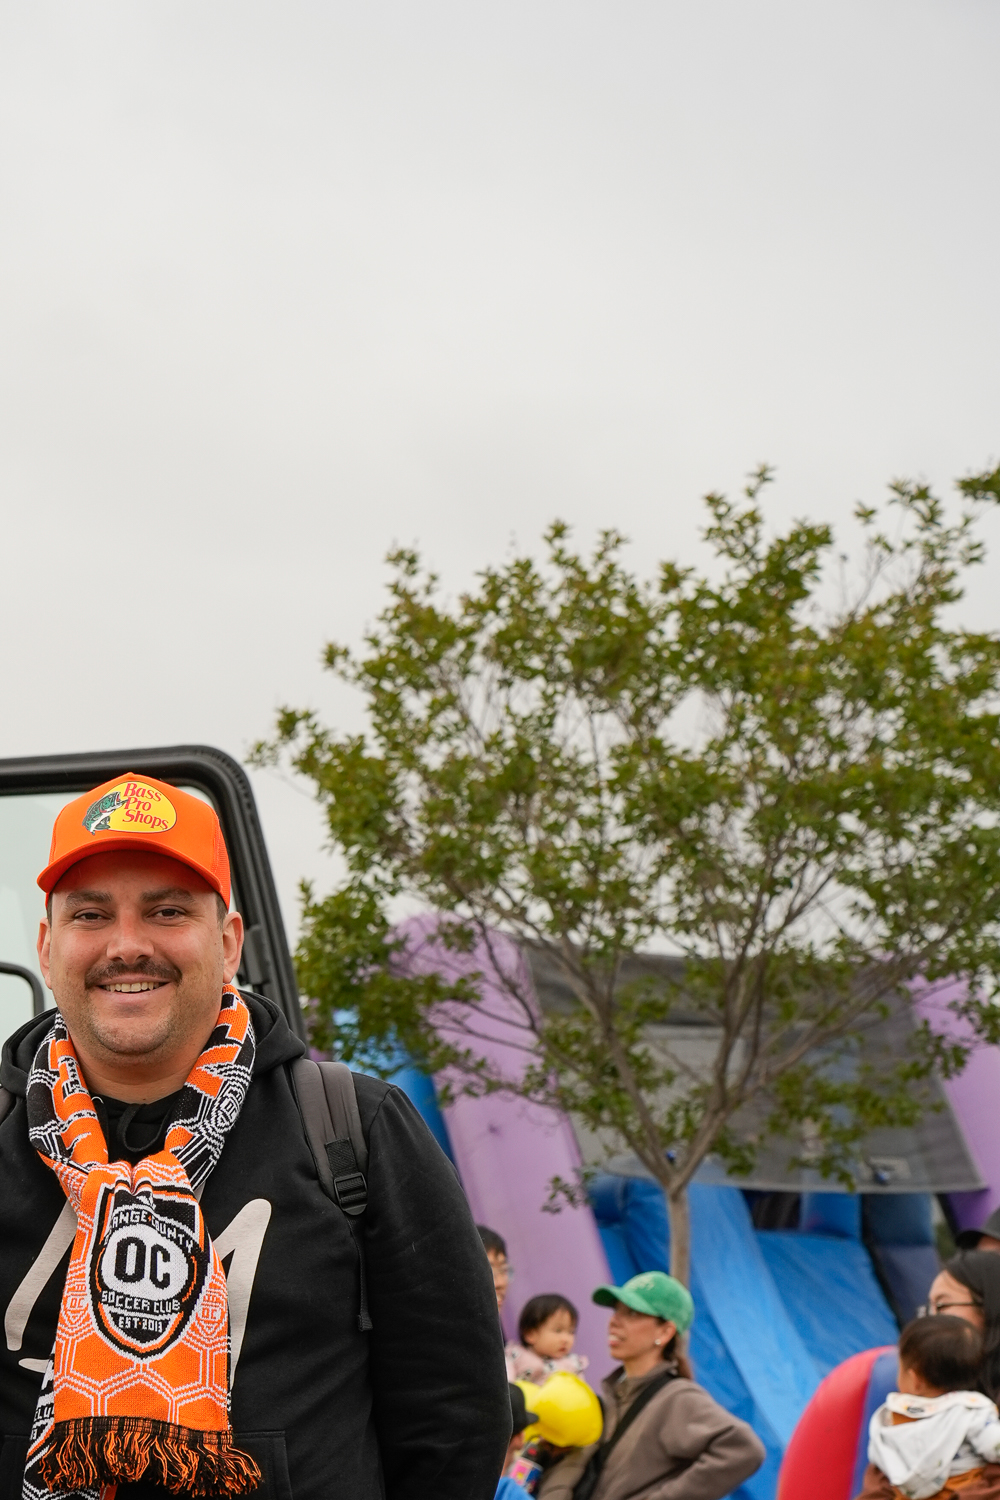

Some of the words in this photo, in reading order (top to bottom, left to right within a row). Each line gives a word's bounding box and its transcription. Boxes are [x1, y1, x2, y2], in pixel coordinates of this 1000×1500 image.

[123, 783, 161, 802] Bass
[124, 796, 151, 811] Pro
[122, 809, 169, 830] Shops
[151, 1217, 194, 1253] COUNTY
[114, 1236, 171, 1290] OC
[102, 1290, 150, 1311] SOCCER
[153, 1300, 180, 1315] CLUB
